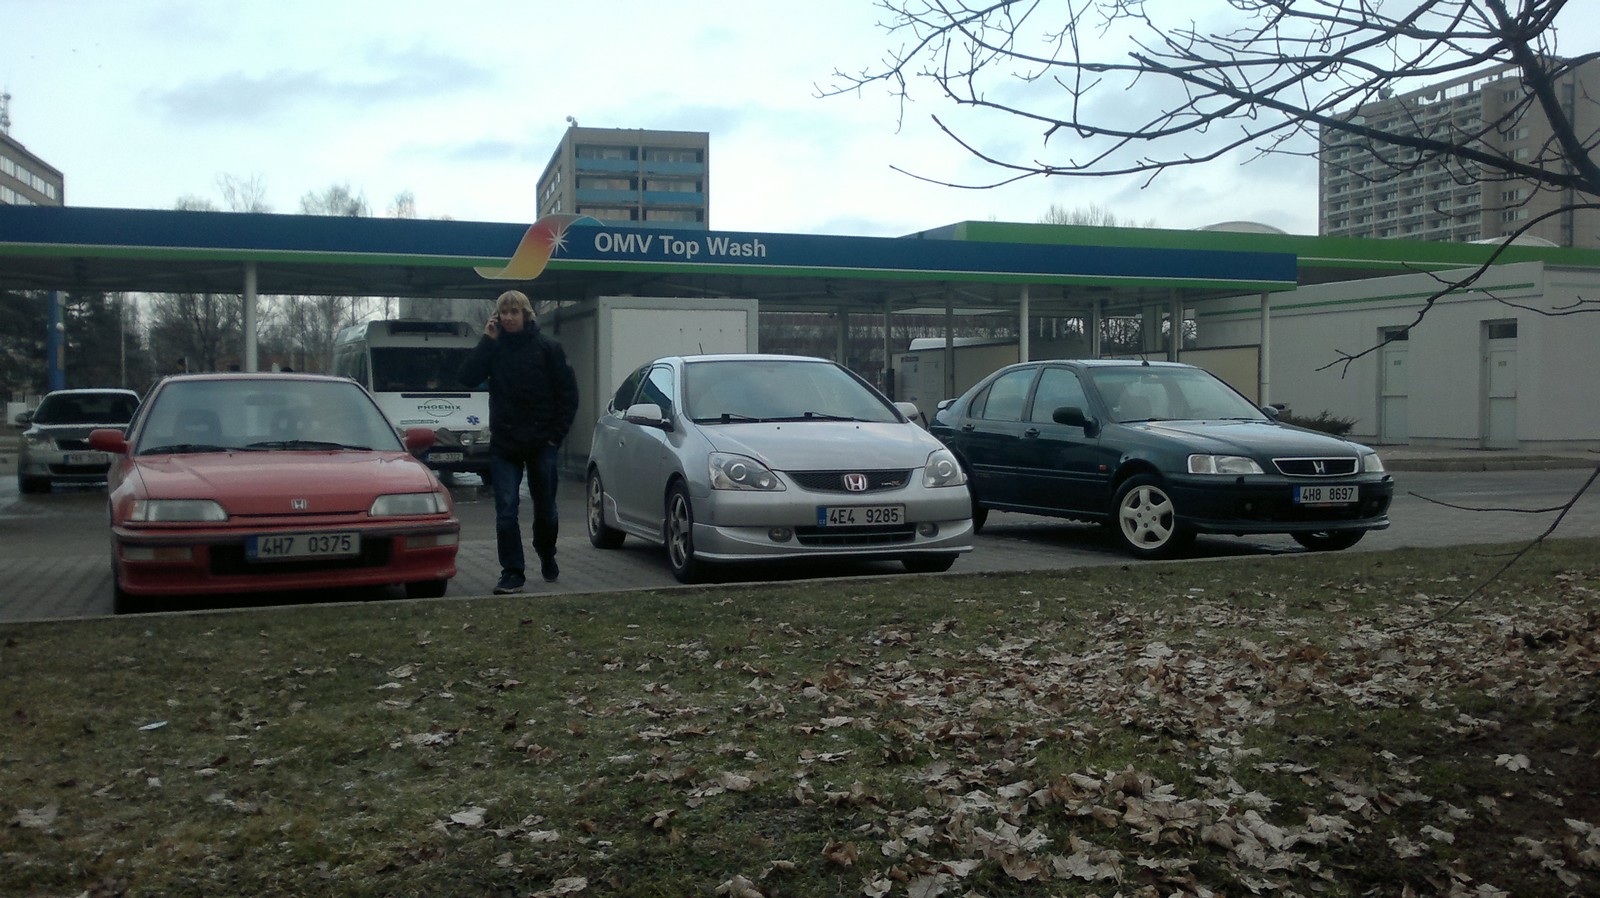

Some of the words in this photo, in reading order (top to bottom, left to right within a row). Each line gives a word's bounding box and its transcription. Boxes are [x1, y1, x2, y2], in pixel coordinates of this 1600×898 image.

[594, 232, 653, 254] OMV
[659, 235, 699, 259] Top
[706, 236, 766, 258] Wash
[1302, 488, 1321, 501] 4H8
[1329, 488, 1354, 501] 8697
[829, 509, 855, 524] 4E4
[866, 508, 898, 523] 9285
[262, 538, 294, 555] 4H7
[308, 535, 352, 552] 0375
